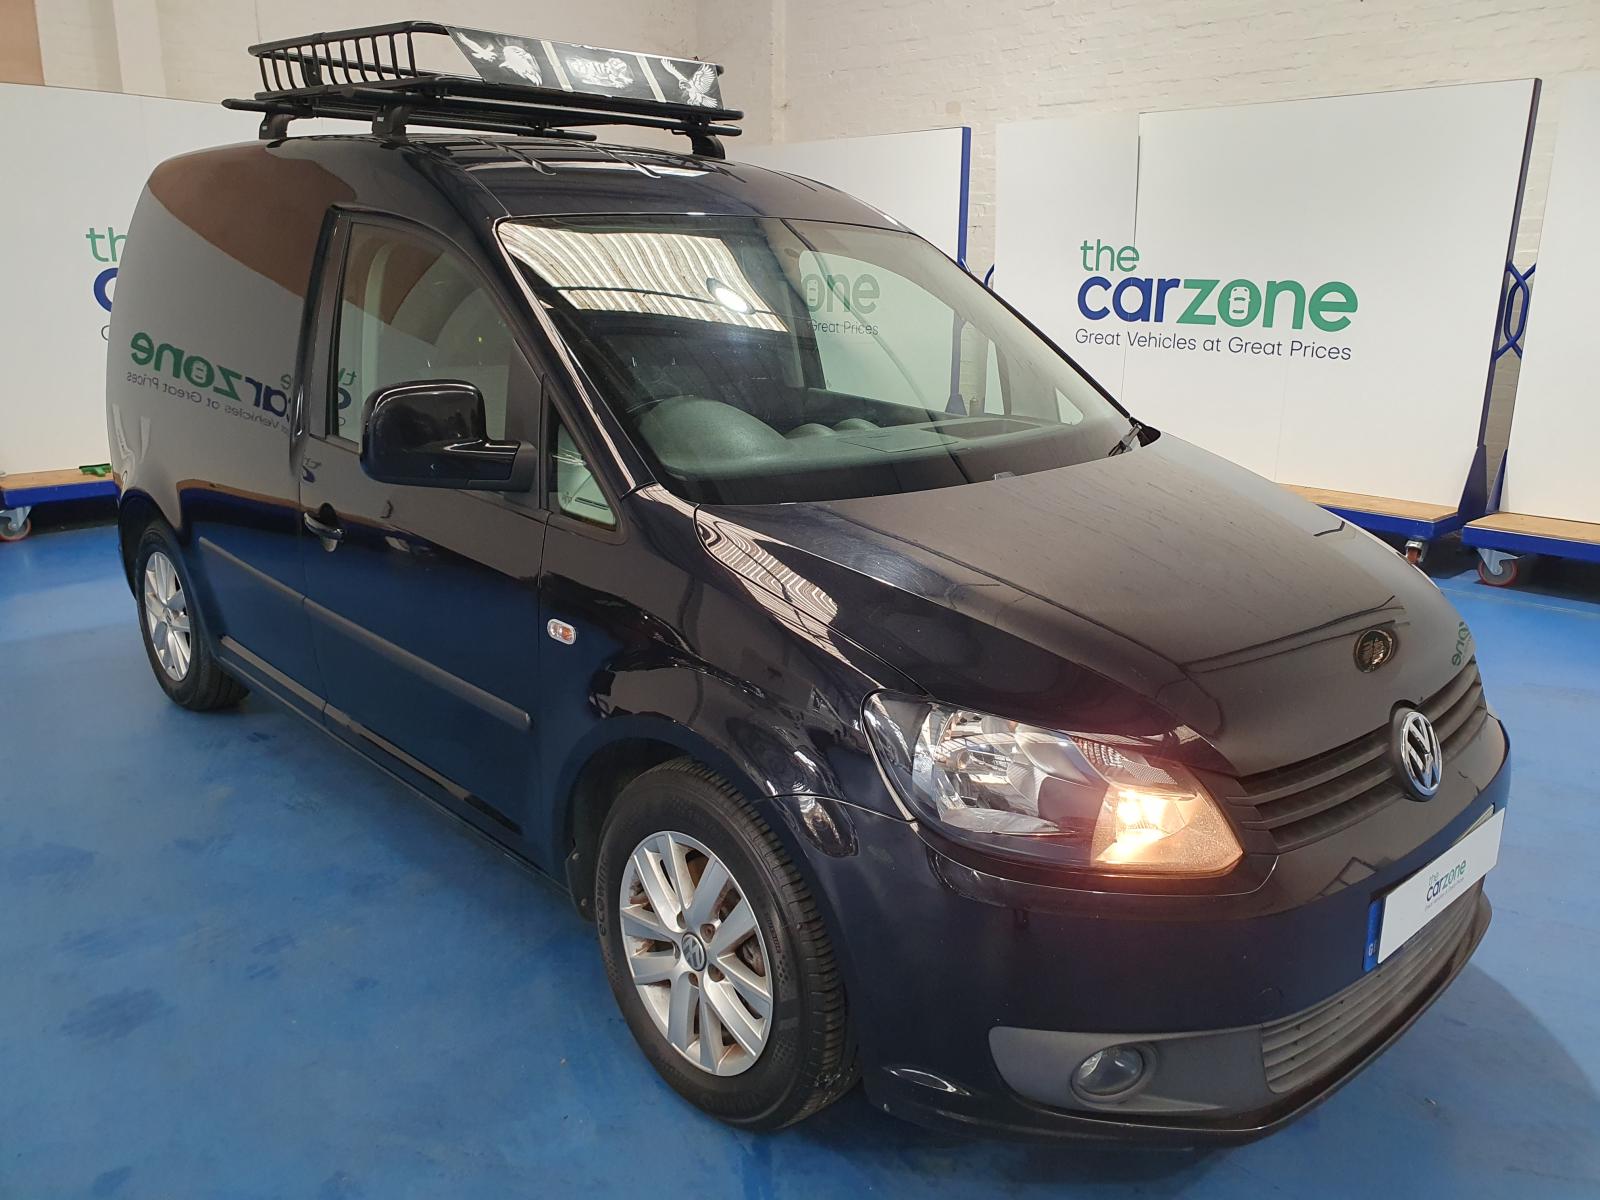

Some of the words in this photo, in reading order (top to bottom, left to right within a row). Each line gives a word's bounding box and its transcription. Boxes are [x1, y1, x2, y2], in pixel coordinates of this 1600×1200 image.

[85, 226, 128, 262] th
[1080, 239, 1140, 272] the
[1077, 275, 1359, 333] carzone
[843, 320, 879, 336] Prices
[1075, 328, 1121, 346] Great
[1127, 331, 1197, 351] Vehicles
[1202, 336, 1221, 353] at
[1228, 336, 1283, 357] Great
[1290, 340, 1352, 361] Prices
[1426, 860, 1467, 902] carzone
